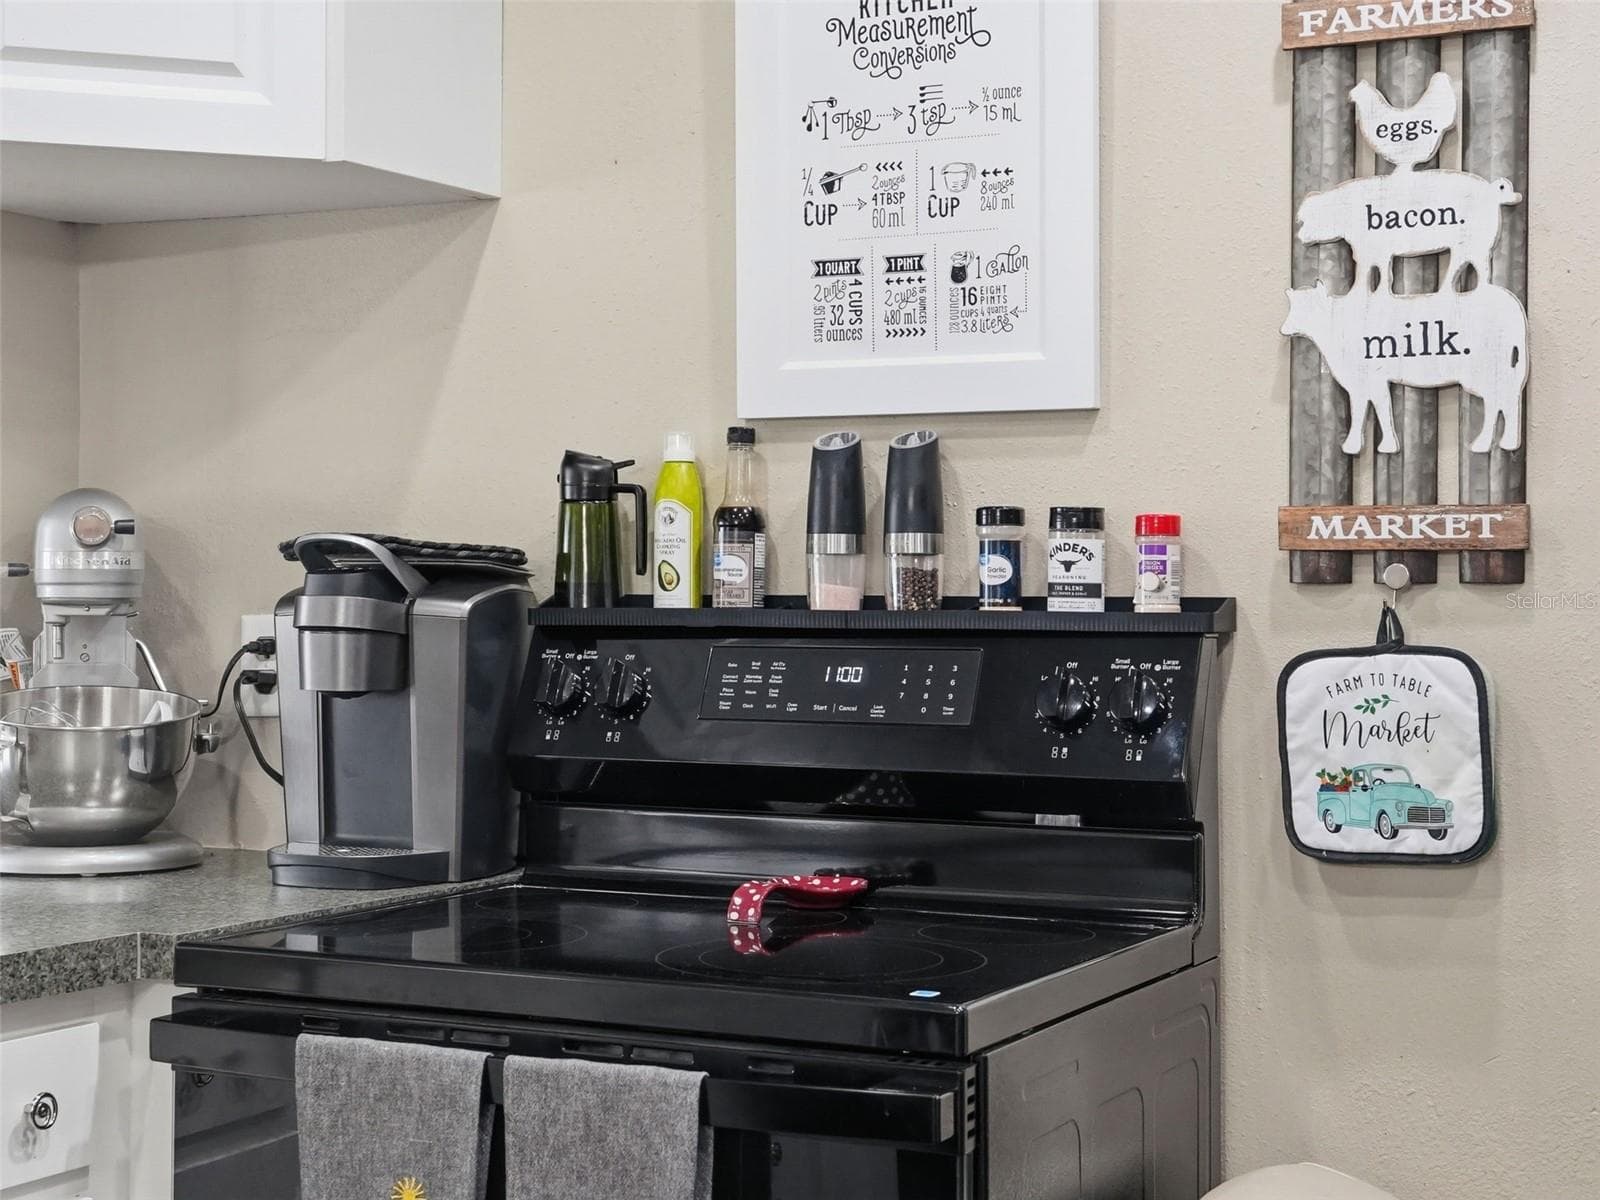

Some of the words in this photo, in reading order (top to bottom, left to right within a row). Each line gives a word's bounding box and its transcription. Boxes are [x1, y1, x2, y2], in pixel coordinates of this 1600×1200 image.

[826, 6, 991, 46] Measurement
[1299, 0, 1514, 37] FARMERS
[853, 42, 956, 79] Conversions
[992, 86, 1022, 100] ounce
[907, 105, 916, 134] 3
[921, 103, 955, 136] tsp
[983, 104, 998, 122] 15
[822, 111, 830, 140] 1
[1376, 119, 1438, 142] eggs.
[872, 175, 879, 190] 2
[930, 166, 936, 191] 1
[980, 180, 988, 194] 8
[880, 192, 906, 206] TBSP
[928, 194, 960, 218] CUP
[980, 196, 997, 212] 240
[804, 200, 838, 226] CUP
[872, 208, 886, 228] 60
[1366, 204, 1466, 231] bacon.
[897, 257, 920, 271] PINT
[976, 256, 982, 279] 1
[814, 284, 822, 302] 2
[824, 279, 848, 303] pints
[884, 290, 894, 306] 2
[894, 286, 918, 310] cups
[960, 286, 978, 306] 16
[980, 284, 1006, 295] EIGHT
[980, 295, 1008, 304] PINTS
[830, 304, 844, 326] 32
[848, 291, 862, 326] CUPS
[884, 310, 900, 325] 480
[960, 308, 978, 318] CUPS
[826, 328, 862, 342] ounces
[1362, 320, 1470, 360] milk.
[1306, 514, 1504, 540] MARKET
[1326, 675, 1364, 699] FARM
[1370, 673, 1384, 686] TO
[1393, 674, 1432, 698] TABLE
[1323, 709, 1440, 749] Market
